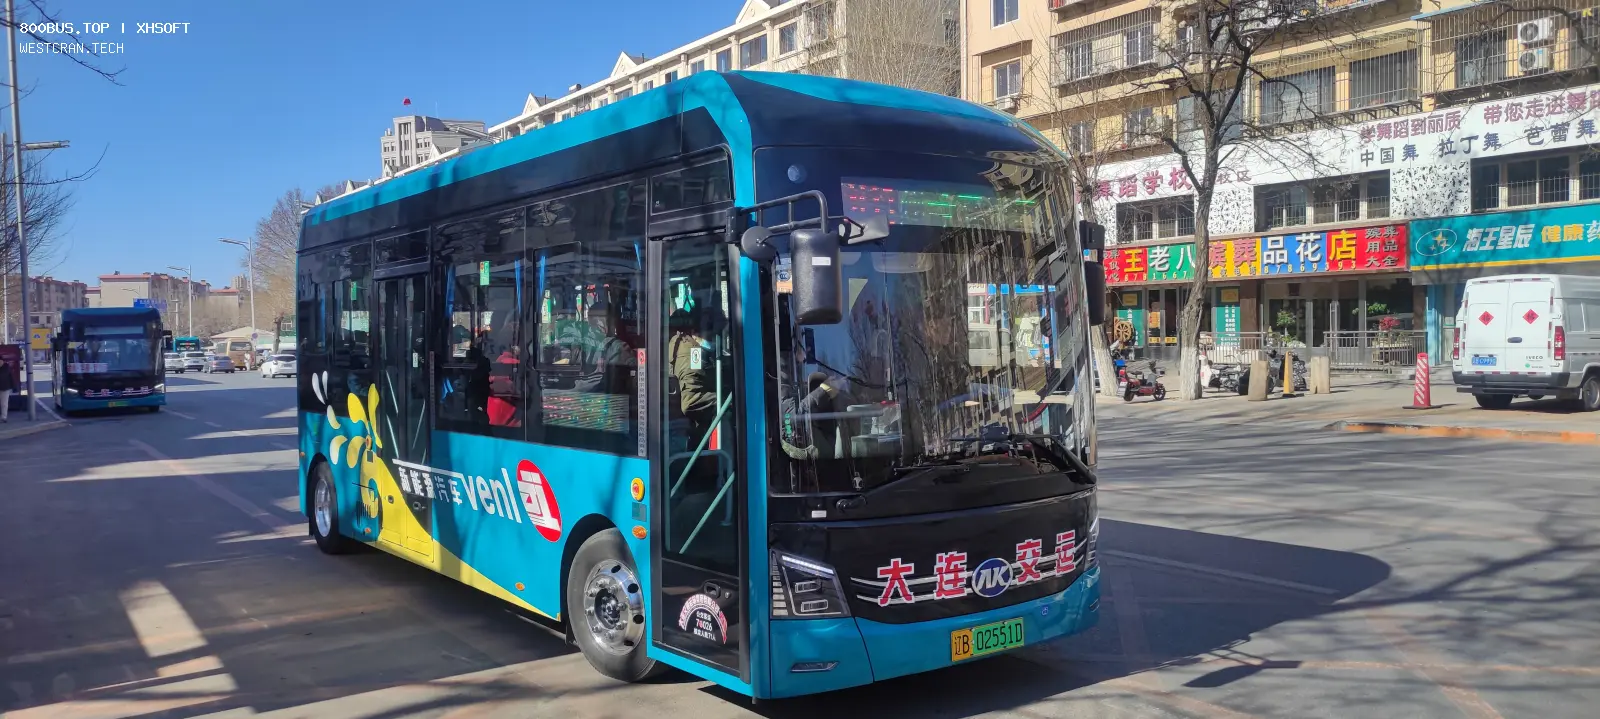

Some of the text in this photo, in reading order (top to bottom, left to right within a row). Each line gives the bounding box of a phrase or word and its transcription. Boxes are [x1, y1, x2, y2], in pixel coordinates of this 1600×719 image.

[1360, 110, 1461, 144] 学舞蹈到丽质
[1360, 117, 1598, 167] 中国舞 拉丁舞 芭蕾舞
[1365, 240, 1399, 253] 用品
[1462, 224, 1535, 252] 海王星辰
[1365, 255, 1399, 267] 大全
[877, 551, 968, 607] 大连
[1016, 529, 1076, 584] 交运
